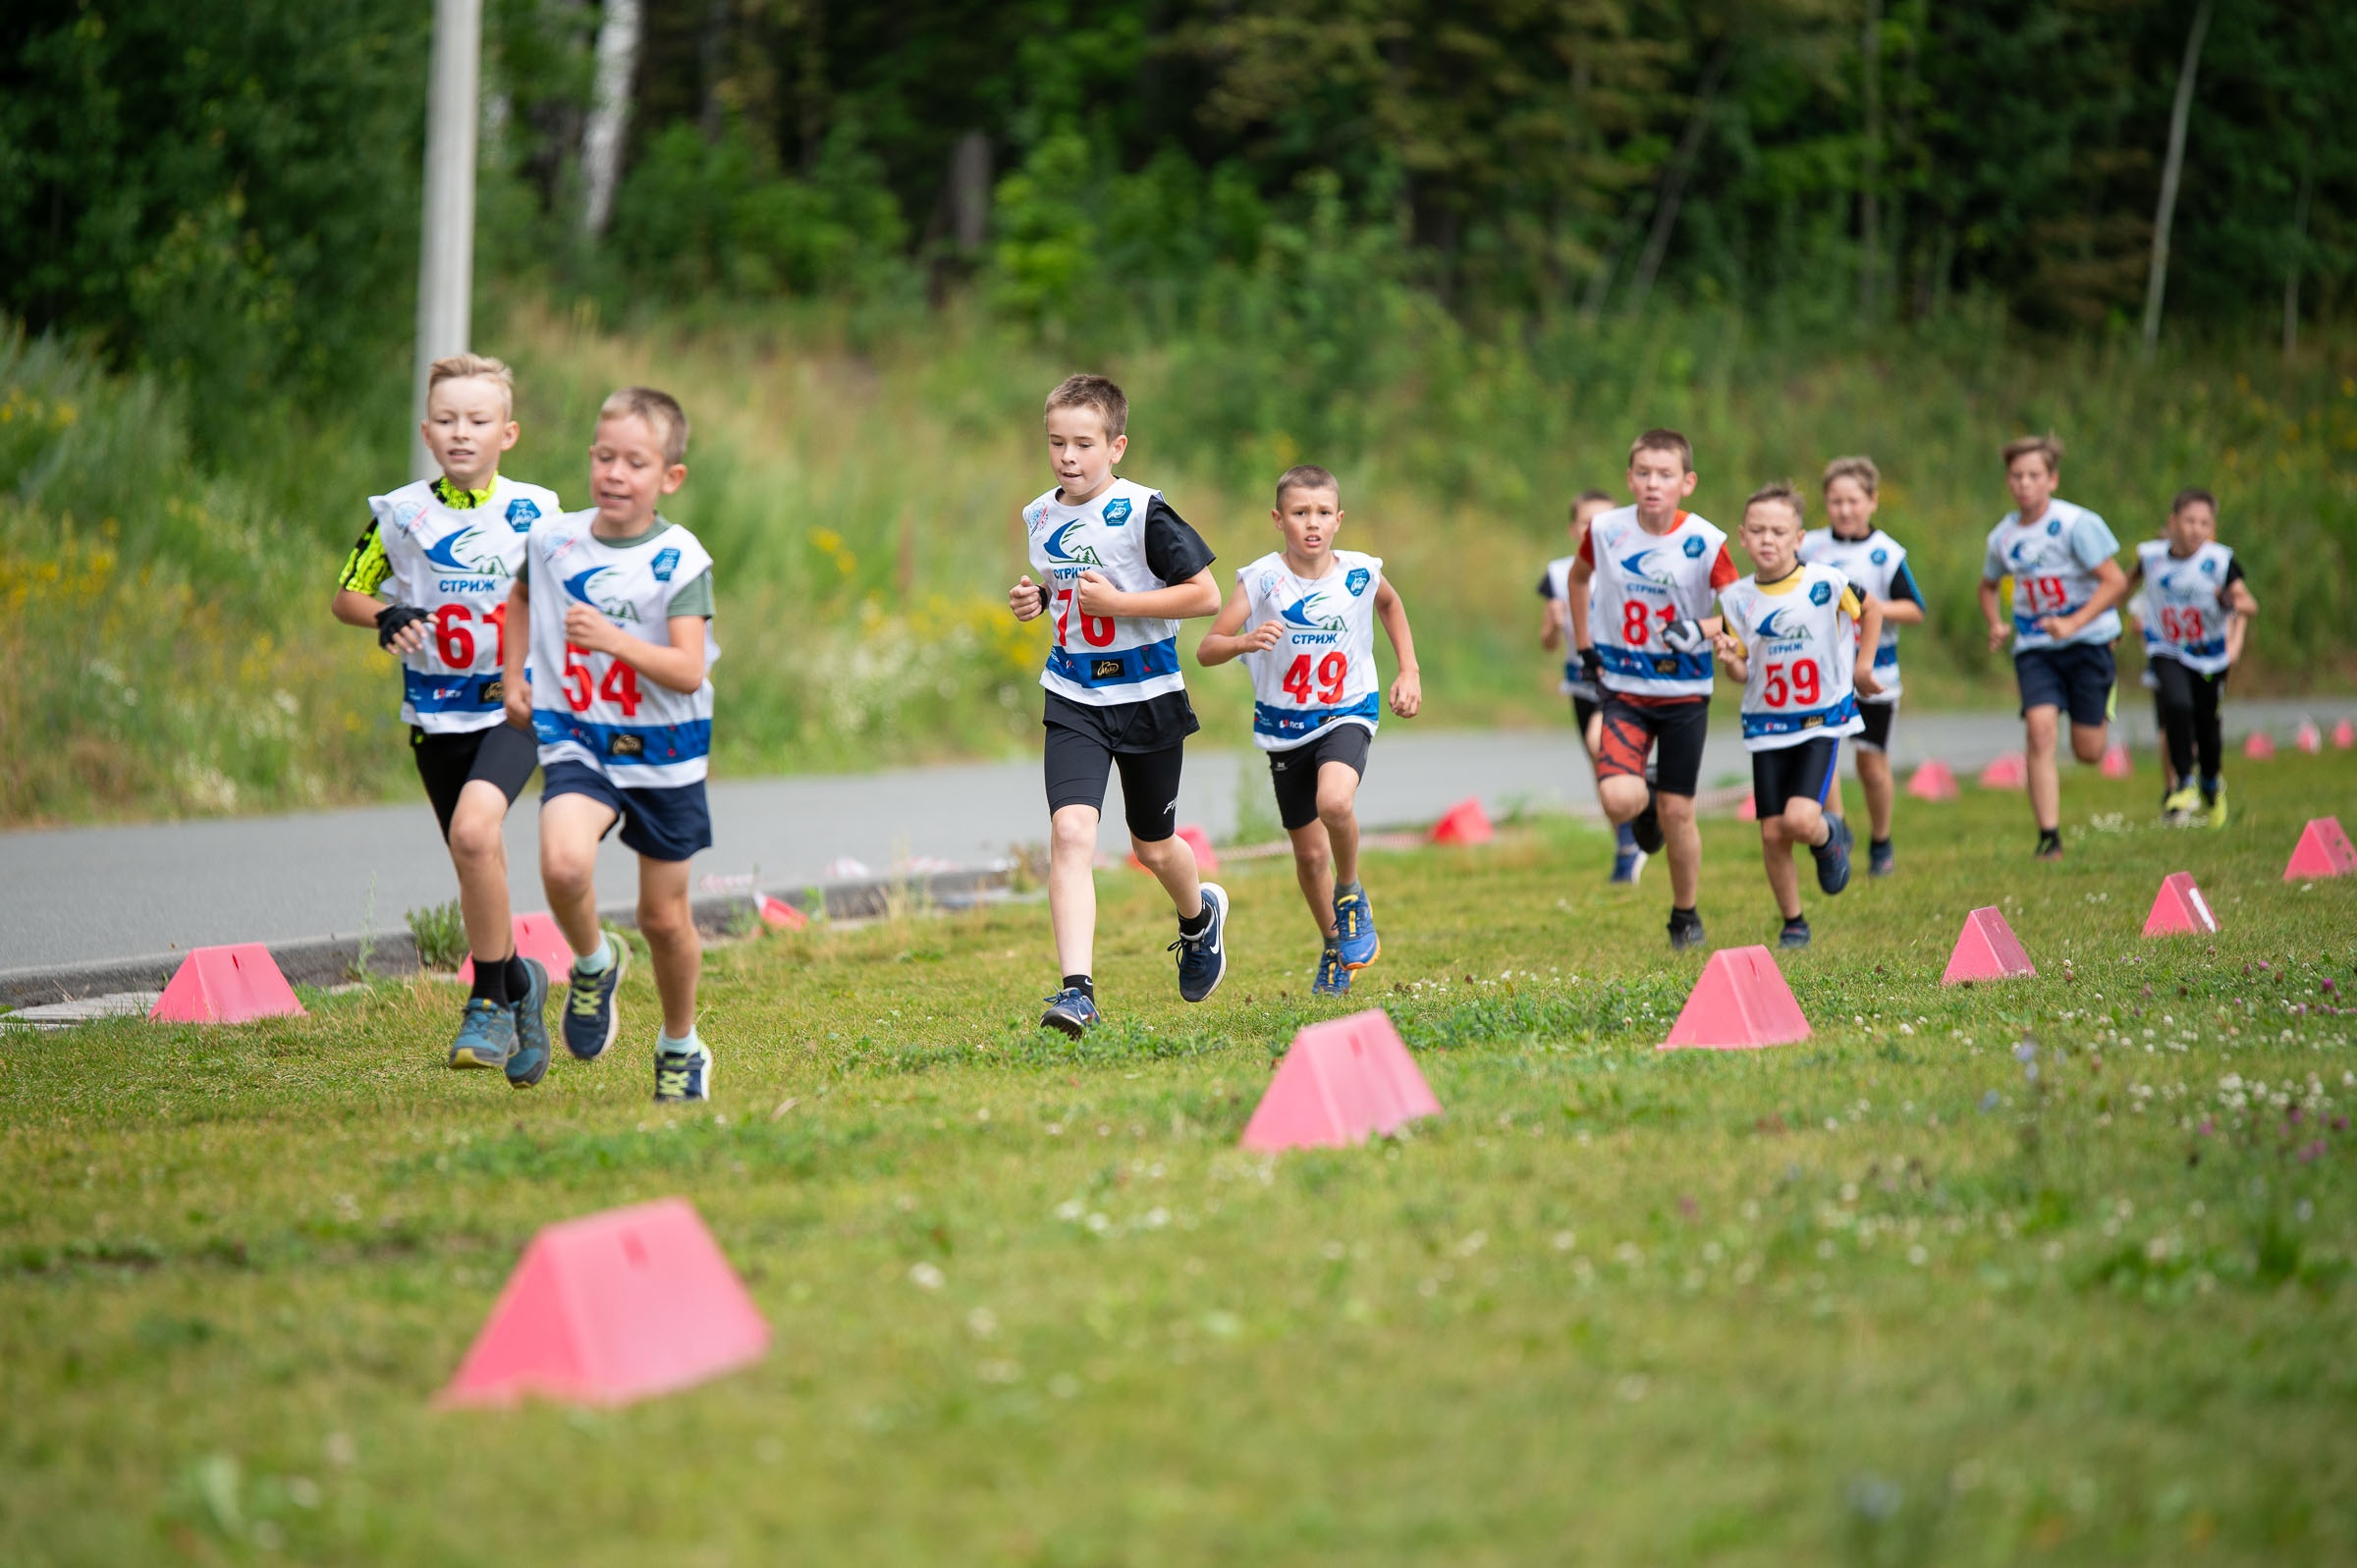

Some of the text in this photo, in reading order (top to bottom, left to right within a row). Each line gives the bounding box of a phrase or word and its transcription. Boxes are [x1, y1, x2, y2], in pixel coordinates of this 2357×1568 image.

[439, 579, 495, 592] СТРИЖ
[435, 602, 507, 669] 61
[1291, 633, 1337, 644] СТРИЖ
[561, 640, 642, 717] 54
[1283, 652, 1348, 704] 49
[1764, 658, 1821, 708] 59
